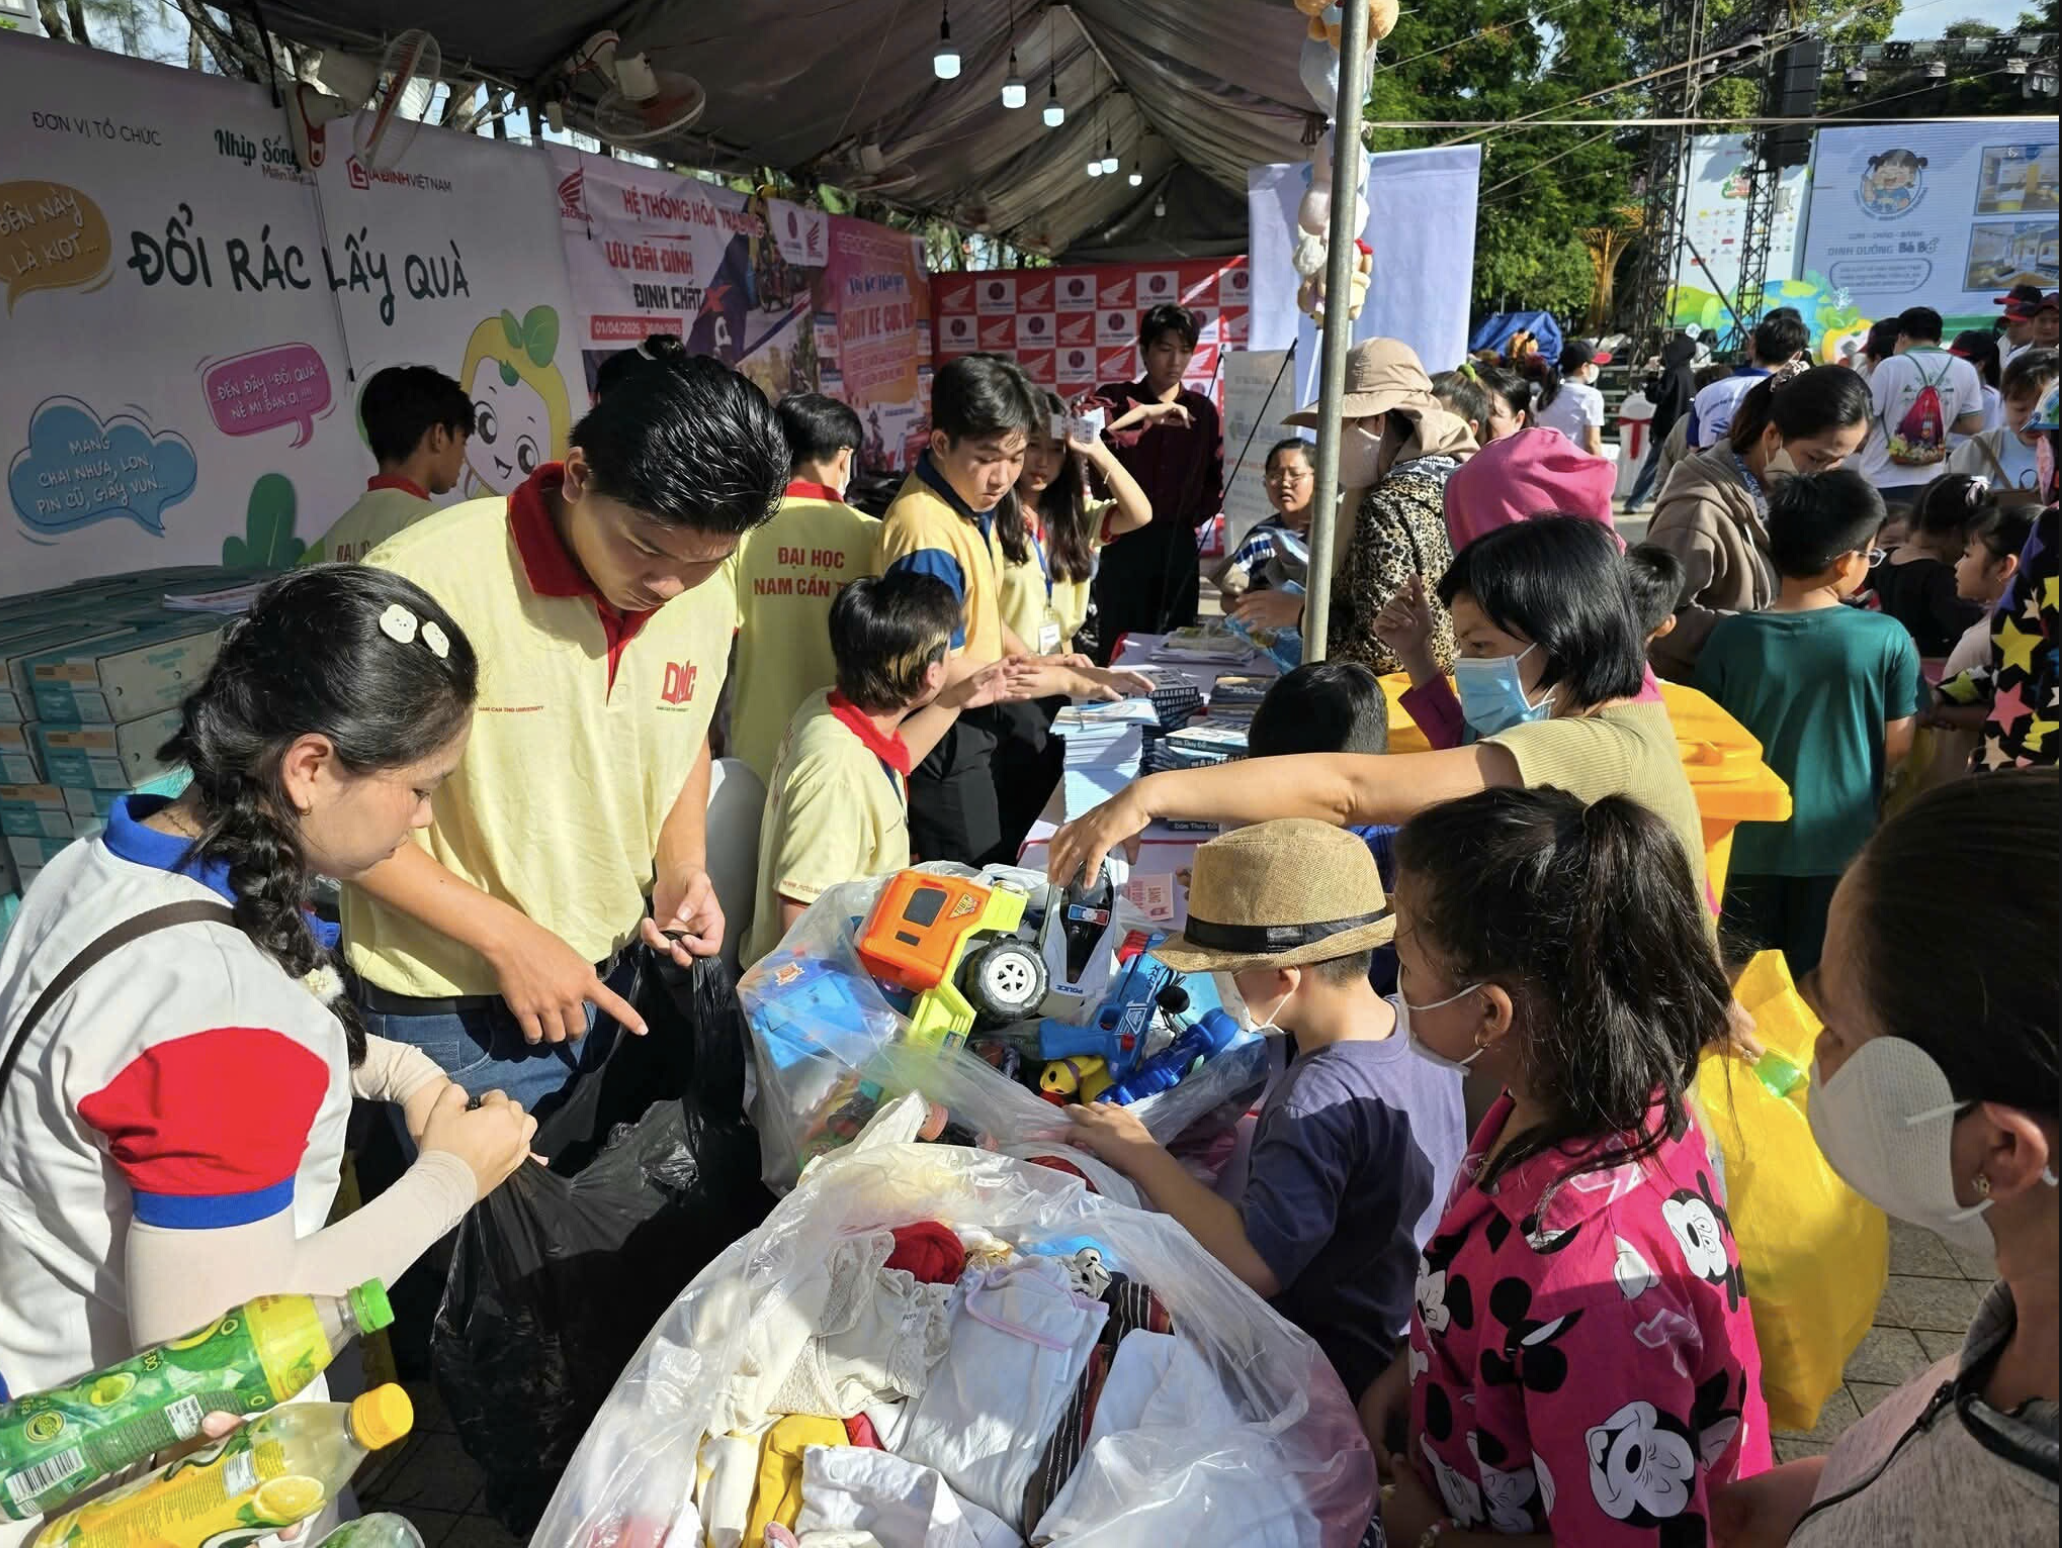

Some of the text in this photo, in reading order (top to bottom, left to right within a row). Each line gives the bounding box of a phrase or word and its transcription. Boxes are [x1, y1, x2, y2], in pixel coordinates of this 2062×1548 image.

[32, 112, 71, 132] ĐƠN
[214, 129, 257, 166] Nhịp
[622, 186, 642, 222] HỆ
[642, 189, 690, 223] THỐNG
[10, 240, 40, 274] LÀ
[127, 203, 470, 326] ĐỔI RÁC LẤY QUÀ
[605, 240, 631, 269] ƯU
[633, 279, 702, 314] ĐỊNH CHẤT
[68, 434, 111, 456] MANG
[38, 469, 72, 487] CHAI
[36, 496, 62, 515] PIN
[778, 547, 845, 572] ĐẠI HỌC
[754, 578, 792, 595] NAM
[1148, 688, 1195, 698] CHALLENGE
[1055, 985, 1083, 994] POLICE
